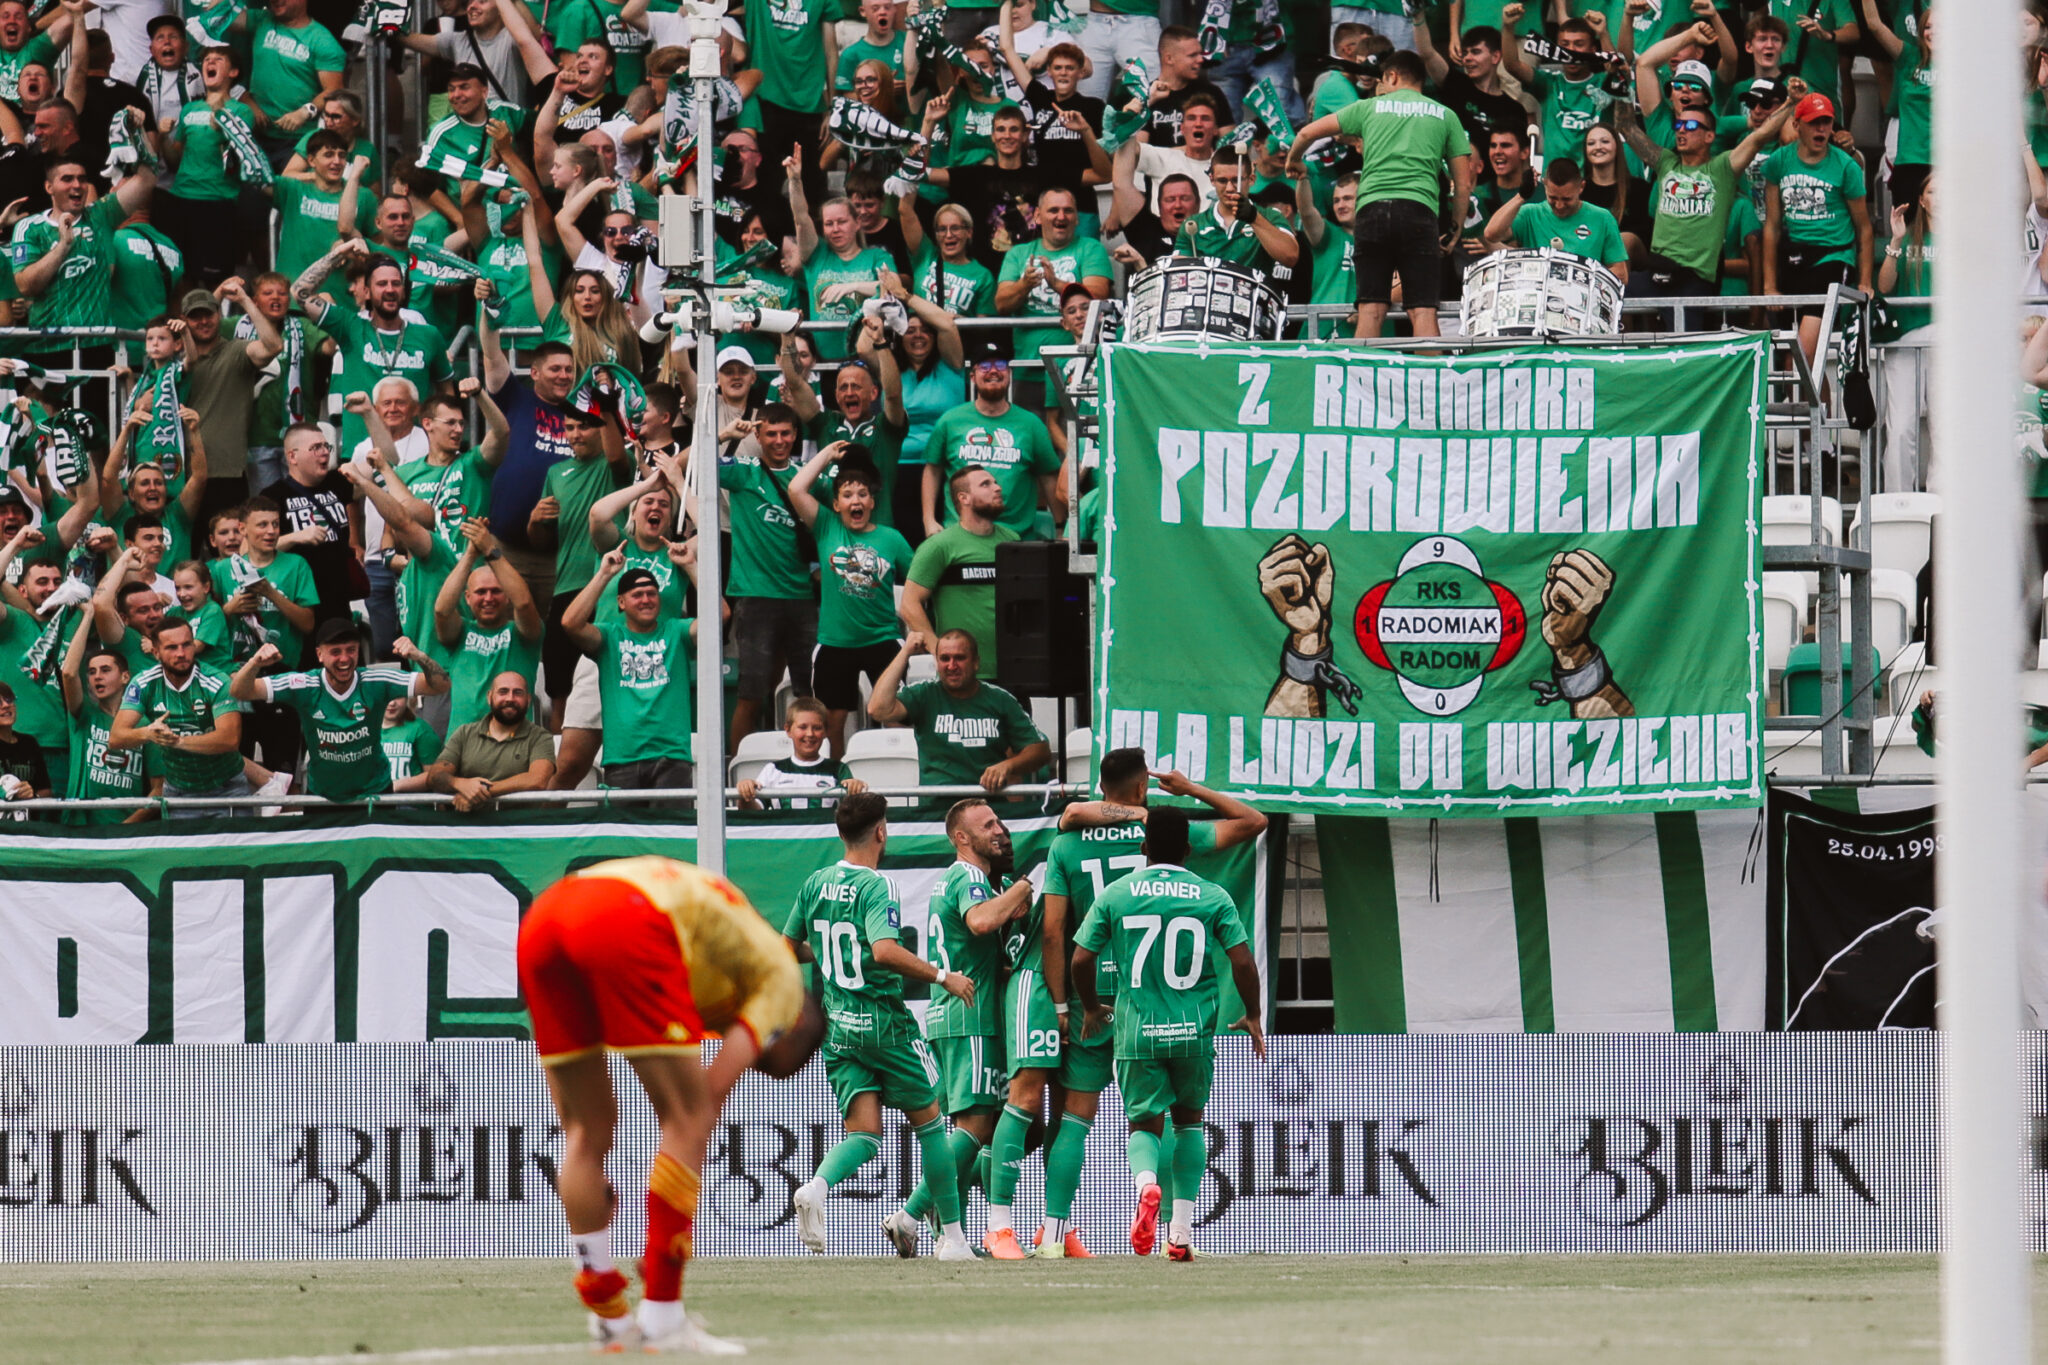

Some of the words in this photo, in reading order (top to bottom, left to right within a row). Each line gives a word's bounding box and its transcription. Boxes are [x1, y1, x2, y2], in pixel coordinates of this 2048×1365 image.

[1152, 109, 1184, 129] Rado
[1375, 100, 1446, 120] RADOMIAK
[1906, 245, 1938, 258] STRU
[1238, 362, 1271, 425] Z
[1313, 364, 1595, 431] RADOMIAKA
[1157, 427, 1700, 533] POZDROWIENIA
[326, 502, 348, 524] 10
[1432, 541, 1445, 558] 9
[1416, 581, 1462, 600] RKS
[1361, 616, 1372, 634] 1
[1381, 616, 1499, 634] RADOMIAK
[1508, 615, 1518, 633] 1
[1402, 651, 1481, 669] RADOM
[1435, 693, 1446, 711] 0
[317, 726, 370, 744] WINDOOR
[934, 713, 1000, 738] RADOMIAK
[319, 745, 373, 763] administrator
[1111, 709, 1207, 782] DLA
[1229, 716, 1376, 790] LUDZI
[1400, 722, 1463, 791] DO
[1487, 712, 1748, 794] WIĘZIENIA
[90, 768, 133, 790] RADOM
[1081, 825, 1146, 841] ROCHA
[818, 884, 857, 903] ALVES
[1129, 881, 1201, 900] VAGNER
[813, 919, 865, 990] 10
[928, 912, 951, 979] 3
[1122, 915, 1206, 991] 70
[1142, 1026, 1198, 1037] visitRadom.pl
[1029, 1030, 1061, 1057] 29
[0, 1127, 158, 1218] EIK
[1555, 1116, 1881, 1227] BLEIK
